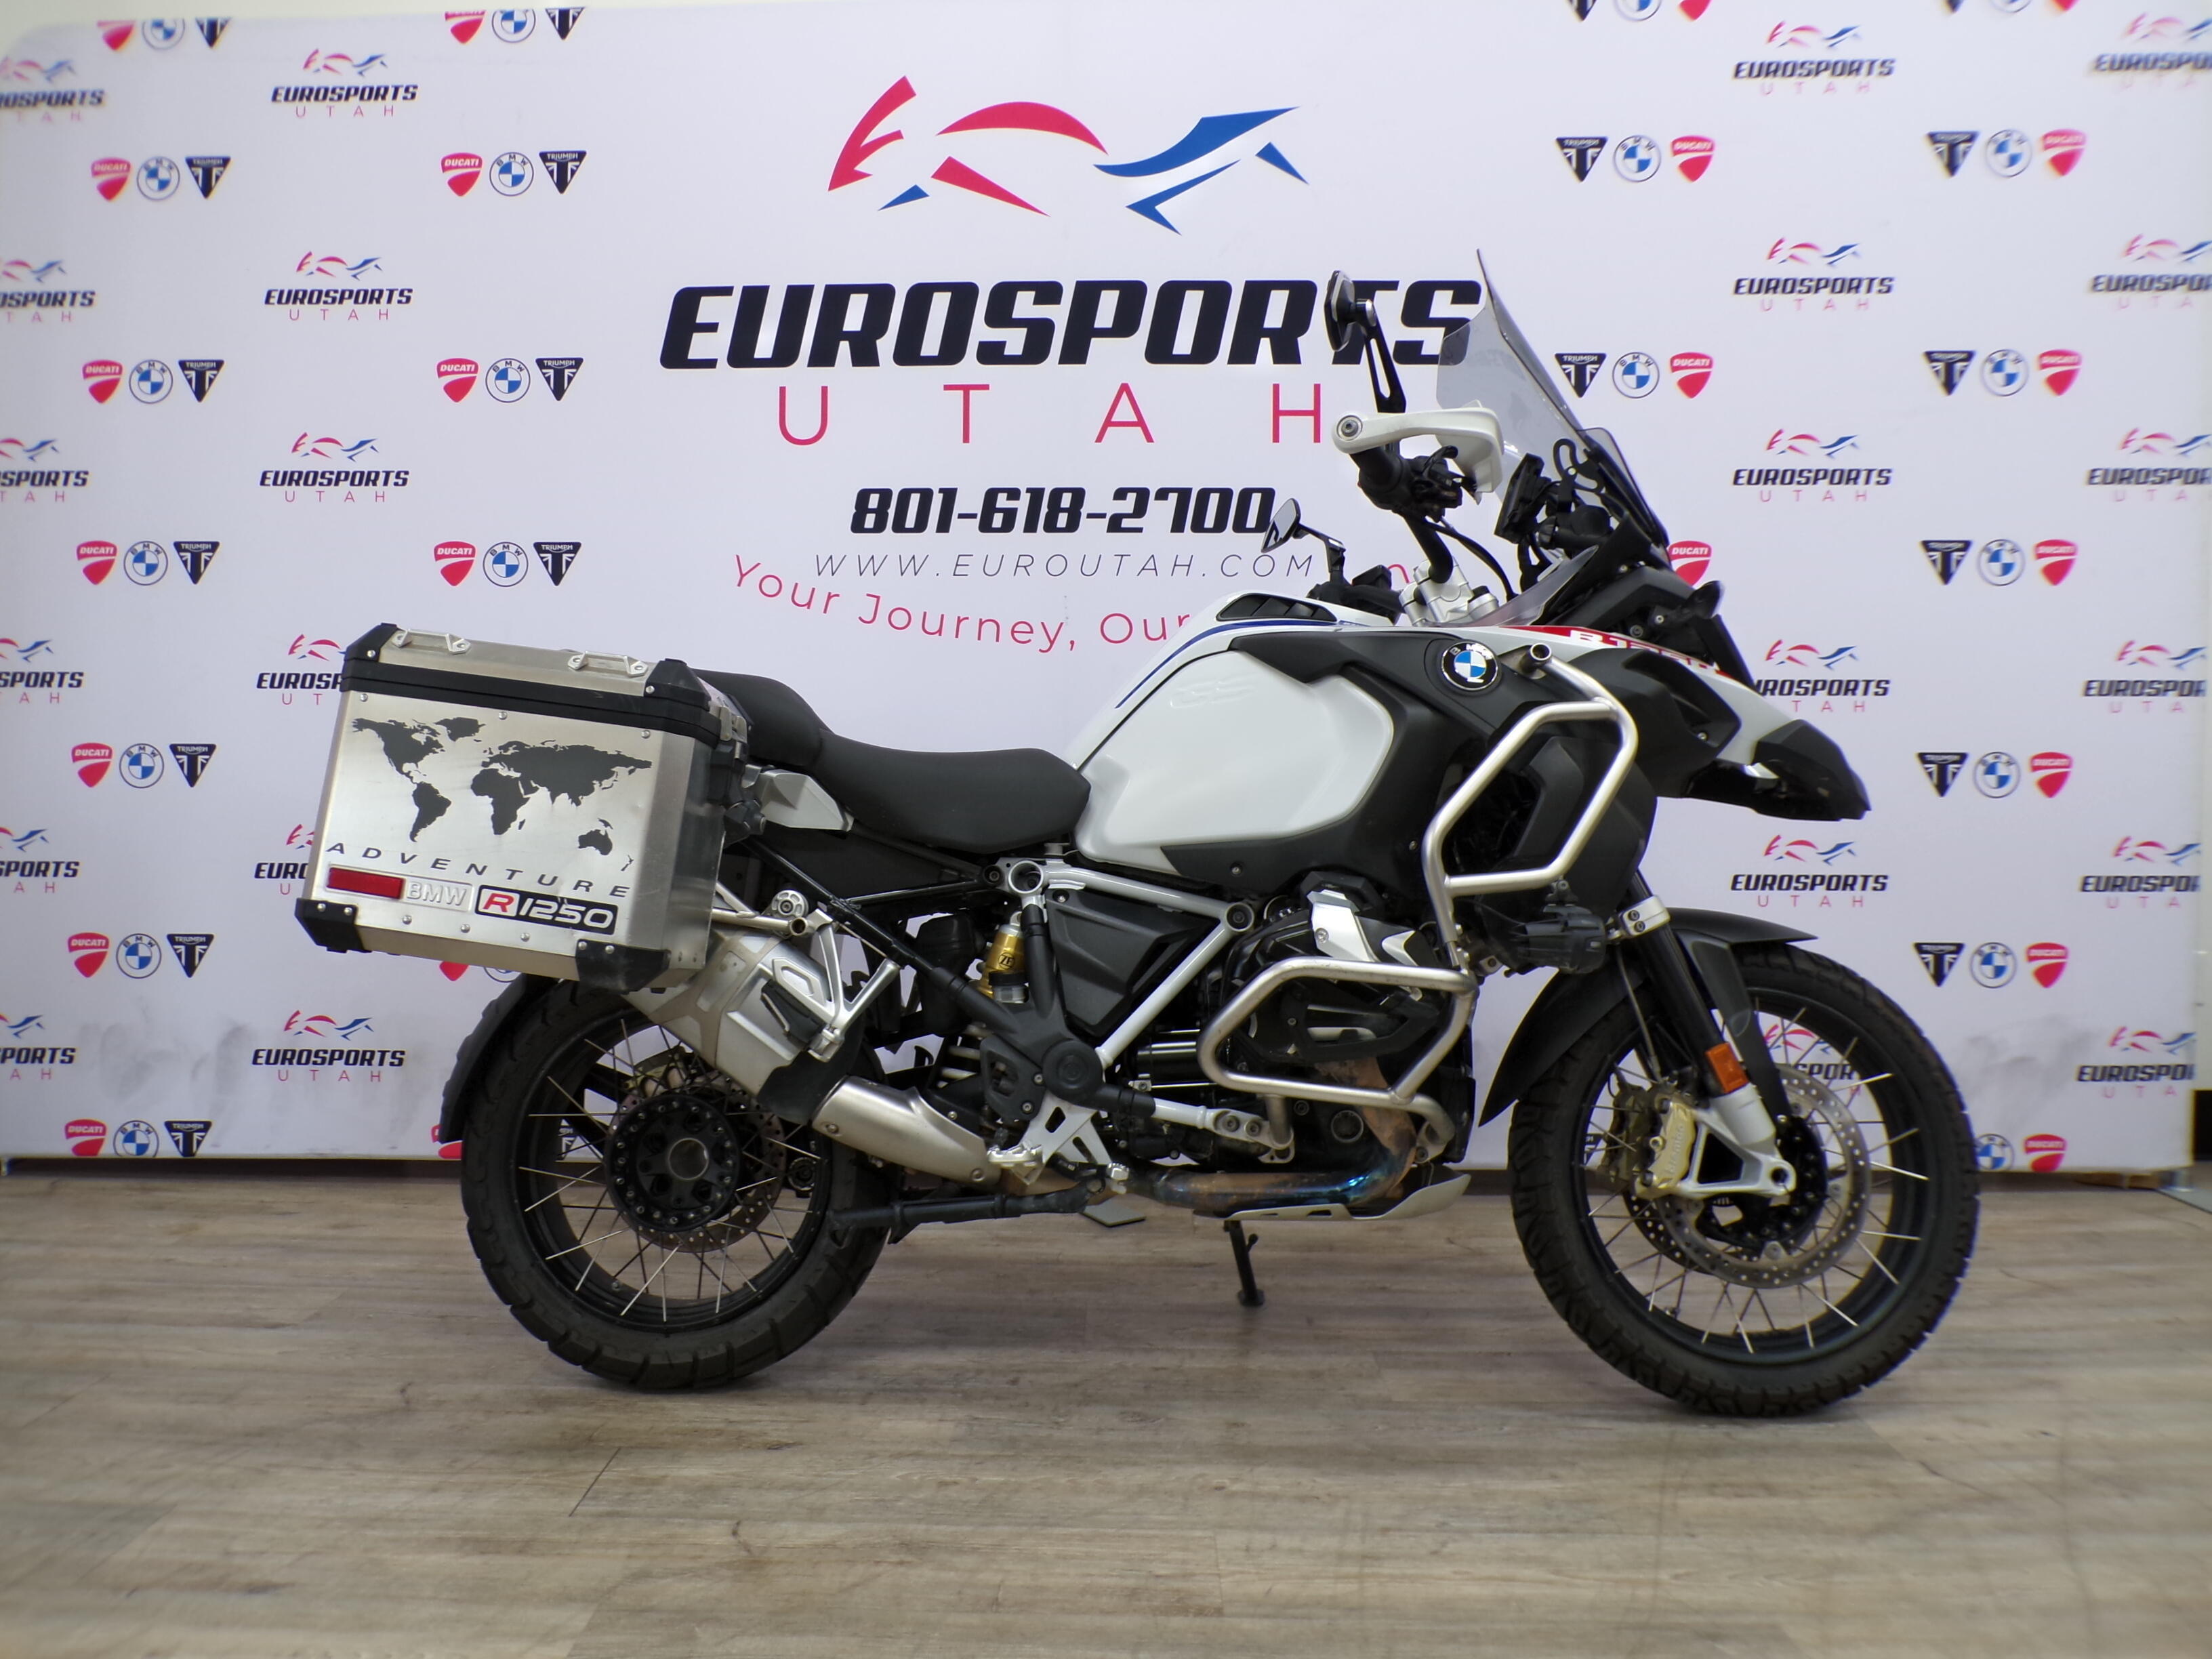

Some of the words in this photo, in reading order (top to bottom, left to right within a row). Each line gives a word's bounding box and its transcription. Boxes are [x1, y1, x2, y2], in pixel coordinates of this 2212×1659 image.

[1733, 59, 1895, 79] EUROSPORTS
[271, 85, 418, 102] EUROSPORTS
[296, 105, 395, 118] UTAH
[444, 158, 480, 167] DUCATI
[496, 154, 529, 167] BMW
[1734, 277, 1893, 295] EUROSPORTS
[264, 288, 413, 305] EUROSPORTS
[289, 309, 390, 321] UTAH
[659, 279, 1482, 370] EUROSPORTS
[85, 365, 120, 373] DUCATI
[440, 363, 476, 372] DUCATI
[492, 361, 525, 373] BMW
[1672, 358, 1710, 367] DUCATI
[778, 383, 1322, 446] UTAH
[0, 470, 89, 487] SPORTS
[260, 470, 409, 487] EUROSPORTS
[1733, 468, 1892, 486] EUROSPORTS
[285, 491, 387, 503] UTAH
[1760, 490, 1867, 502] UTAH
[850, 487, 1276, 534] 801-618-2700
[80, 546, 114, 554] DUCATI
[436, 547, 473, 556] DUCATI
[489, 544, 523, 556] BMW
[1671, 546, 1708, 556] DUCATI
[815, 554, 1313, 578] WWW.EUROUTAH.COM
[735, 554, 840, 615] Your
[857, 593, 1076, 653] Journey,
[326, 842, 630, 898] ADVENTURE
[1730, 874, 1889, 891] EUROSPORTS
[405, 882, 468, 906] BMW
[1757, 895, 1864, 908] UTAH
[71, 939, 106, 947] DUCATI
[0, 1047, 76, 1065] PORTS
[252, 1048, 405, 1067] EUROSPORTS
[278, 1069, 382, 1082] UTAH
[68, 1125, 103, 1133] DUCATI
